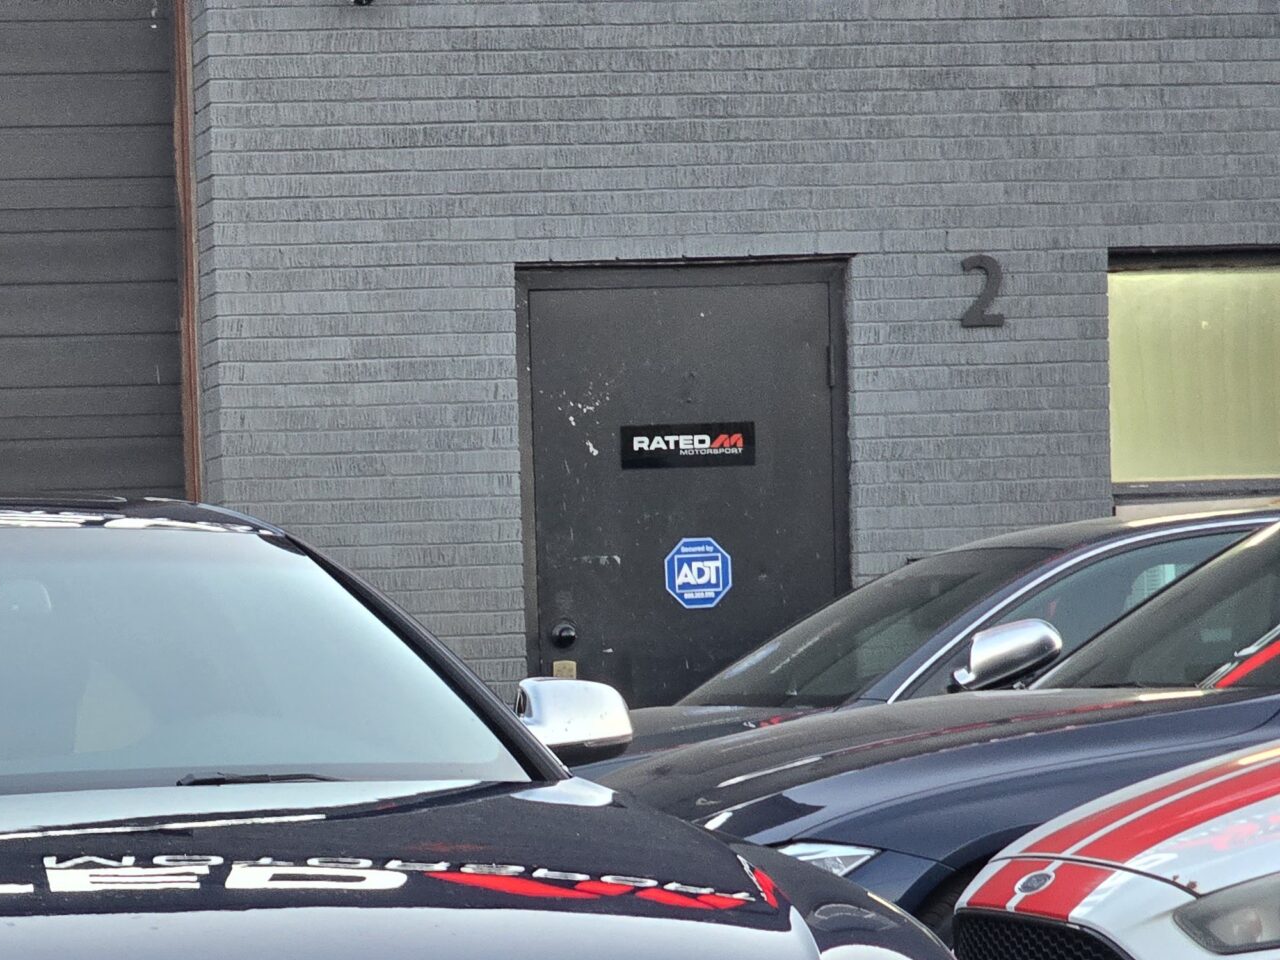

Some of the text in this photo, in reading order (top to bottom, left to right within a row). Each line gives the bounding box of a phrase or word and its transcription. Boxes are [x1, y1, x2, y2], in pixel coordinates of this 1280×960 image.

[961, 254, 1004, 328] 2
[633, 434, 711, 451] RATED
[680, 447, 744, 456] MOTORSPORT
[677, 560, 720, 585] ADT
